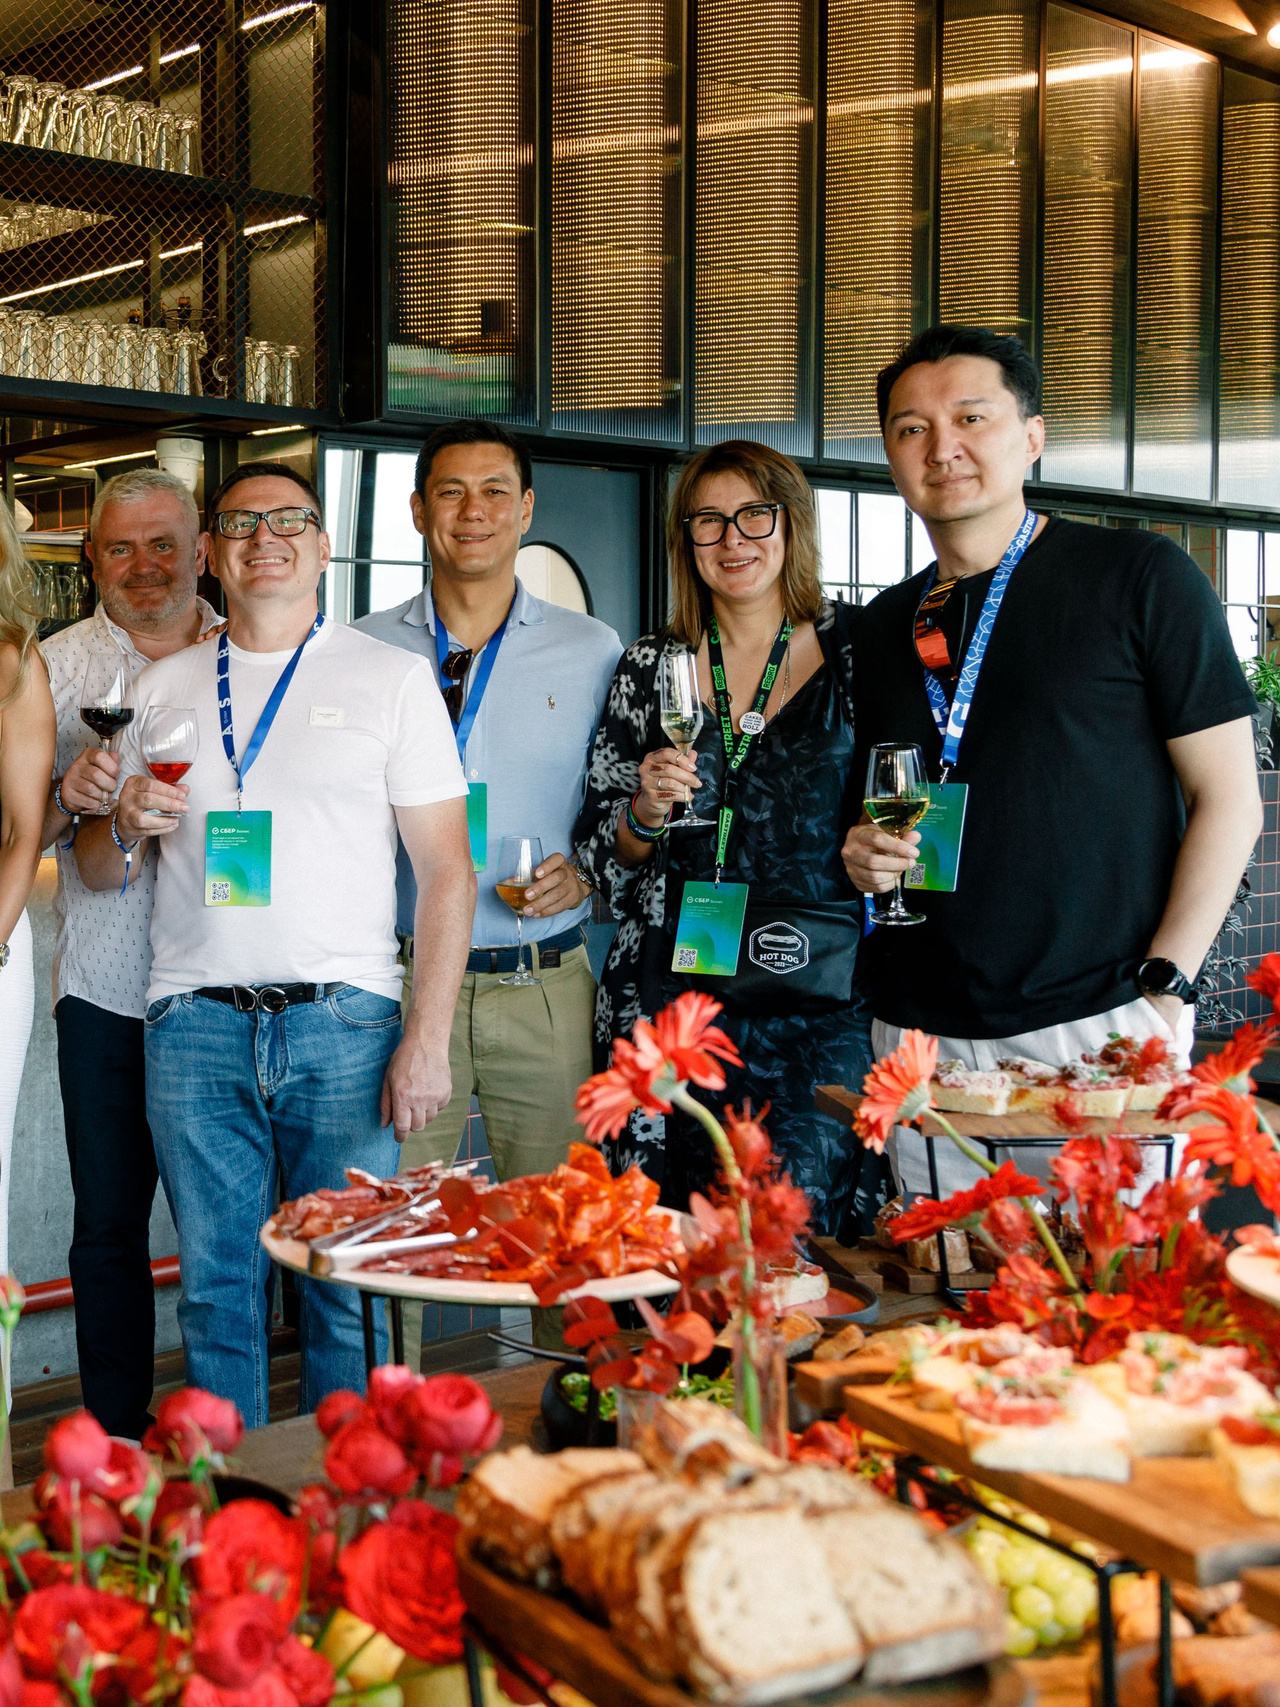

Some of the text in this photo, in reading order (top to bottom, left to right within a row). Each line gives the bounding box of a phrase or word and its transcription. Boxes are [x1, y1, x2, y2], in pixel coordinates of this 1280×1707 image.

[764, 666, 776, 689] REBRO
[720, 716, 734, 766] ASTREET
[731, 733, 753, 769] GASTR
[722, 813, 732, 851] GASTREET
[760, 953, 799, 964] HOT DOG
